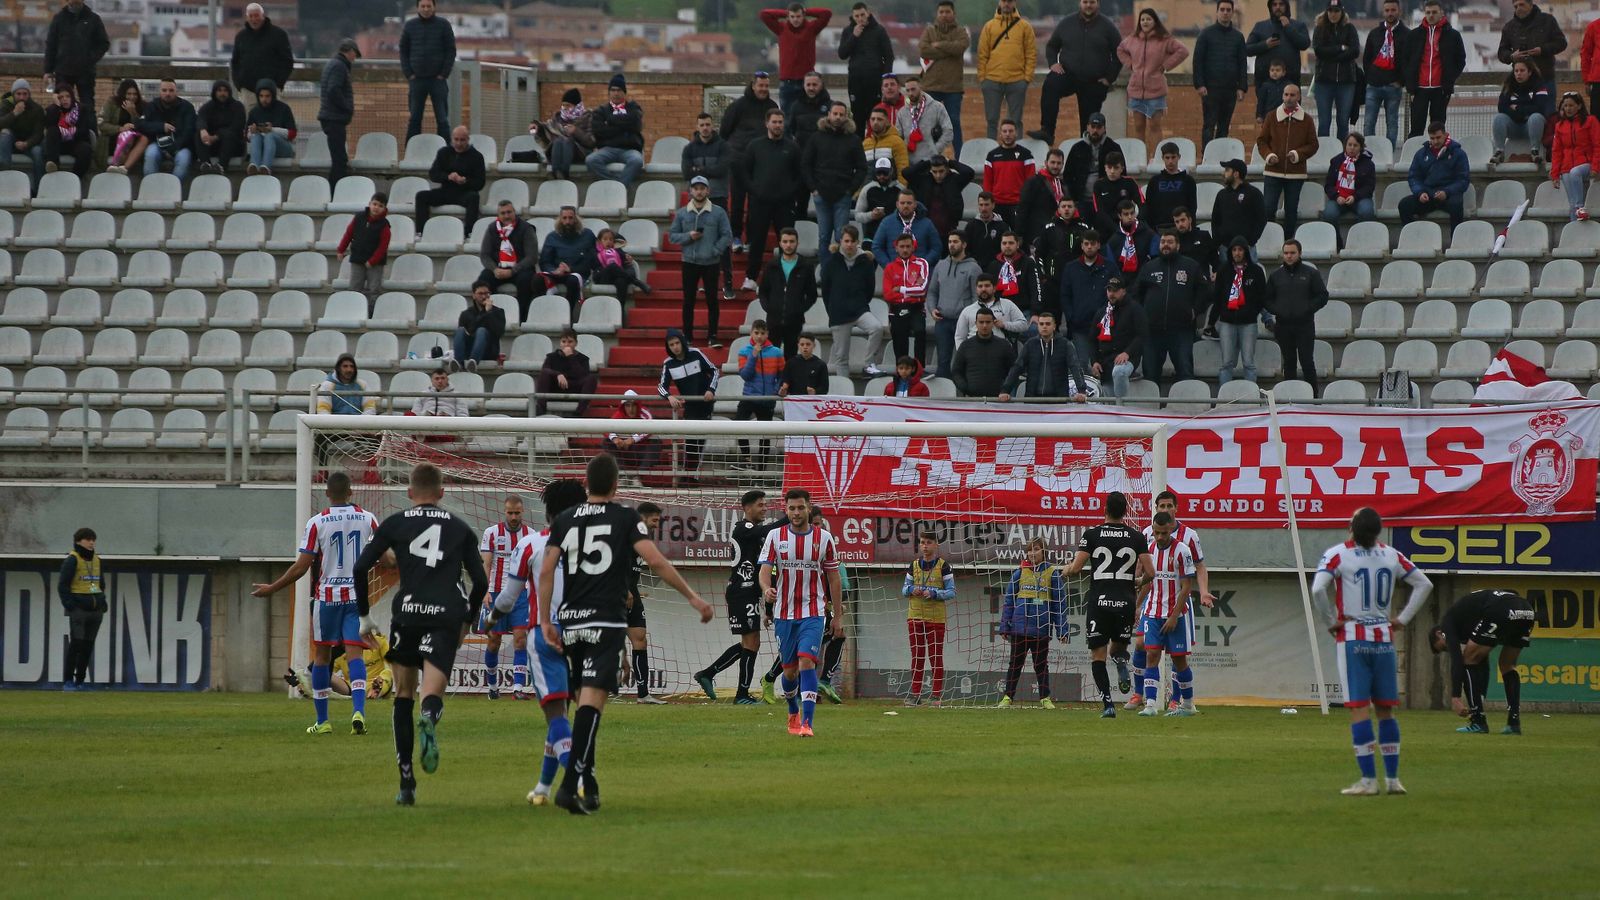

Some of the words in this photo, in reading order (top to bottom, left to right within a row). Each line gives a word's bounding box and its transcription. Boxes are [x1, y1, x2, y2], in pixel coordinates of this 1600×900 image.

[891, 420, 1485, 495] ALGECIRAS
[321, 514, 343, 524] PABLO
[426, 510, 450, 519] LUNA
[1189, 498, 1265, 513] FONDO
[1278, 498, 1324, 513] SUR
[329, 530, 361, 570] 11
[409, 524, 444, 569] 4
[560, 524, 613, 575] 15
[685, 546, 694, 557] la
[697, 546, 731, 557] actuali
[1410, 523, 1551, 565] SER
[1092, 546, 1137, 580] 22
[1354, 567, 1393, 612] 10
[448, 668, 515, 687] UESTOS
[1497, 664, 1600, 691] escarg
